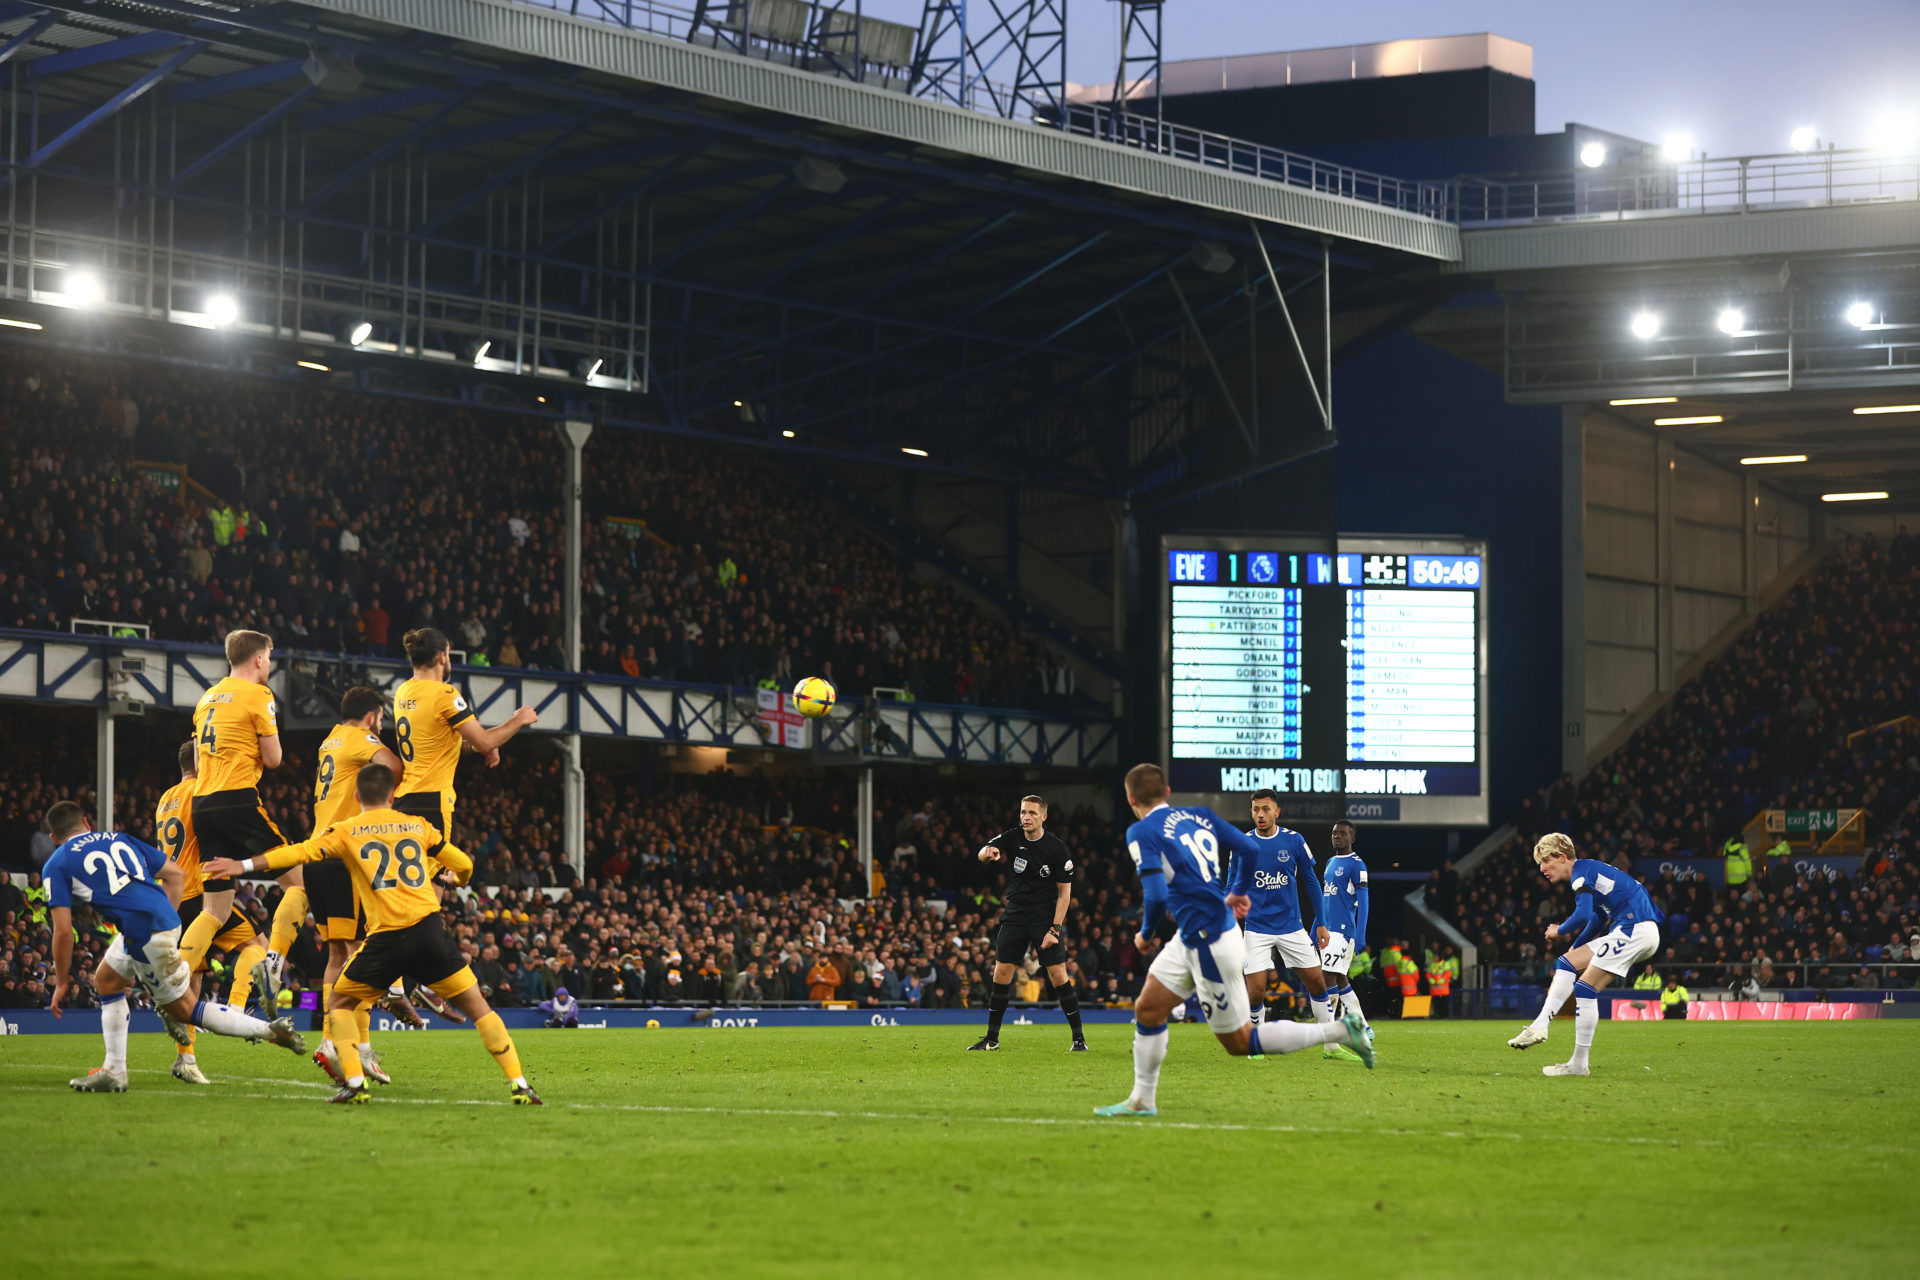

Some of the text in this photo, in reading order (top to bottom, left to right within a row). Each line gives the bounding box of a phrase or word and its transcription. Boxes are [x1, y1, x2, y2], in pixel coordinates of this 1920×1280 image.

[1175, 553, 1205, 581] EVE
[1228, 554, 1237, 582] 1
[1289, 555, 1298, 583] 1
[1413, 560, 1480, 584] 50:49
[1228, 590, 1294, 602] PICKFORD 1
[1219, 605, 1295, 617] TARKOWSKI 2
[1220, 621, 1278, 631] PATTERSON
[1240, 637, 1295, 649] MCNEIL 7
[1243, 653, 1278, 662] ONANA
[1236, 668, 1278, 678] GORDON
[1252, 684, 1278, 693] MINA
[1248, 699, 1278, 709] IWOBI
[1216, 715, 1278, 725] MYKOLENKO
[201, 707, 216, 753] 4
[1236, 731, 1278, 740] MAUPAY
[396, 716, 414, 763] 8
[1215, 746, 1242, 756] GANA
[1245, 746, 1278, 756] GUEYE
[1221, 767, 1289, 792] WELCOME
[1291, 768, 1311, 792] TO
[1387, 769, 1427, 794] PARK
[1787, 816, 1806, 826] EXIT
[352, 823, 424, 836] J.MOUTINHO
[71, 832, 119, 852] MAUPAY
[1179, 828, 1221, 883] 19
[83, 841, 146, 896] 20
[360, 838, 426, 891] 28
[1254, 870, 1289, 888] Stake
[1323, 953, 1340, 967] 27
